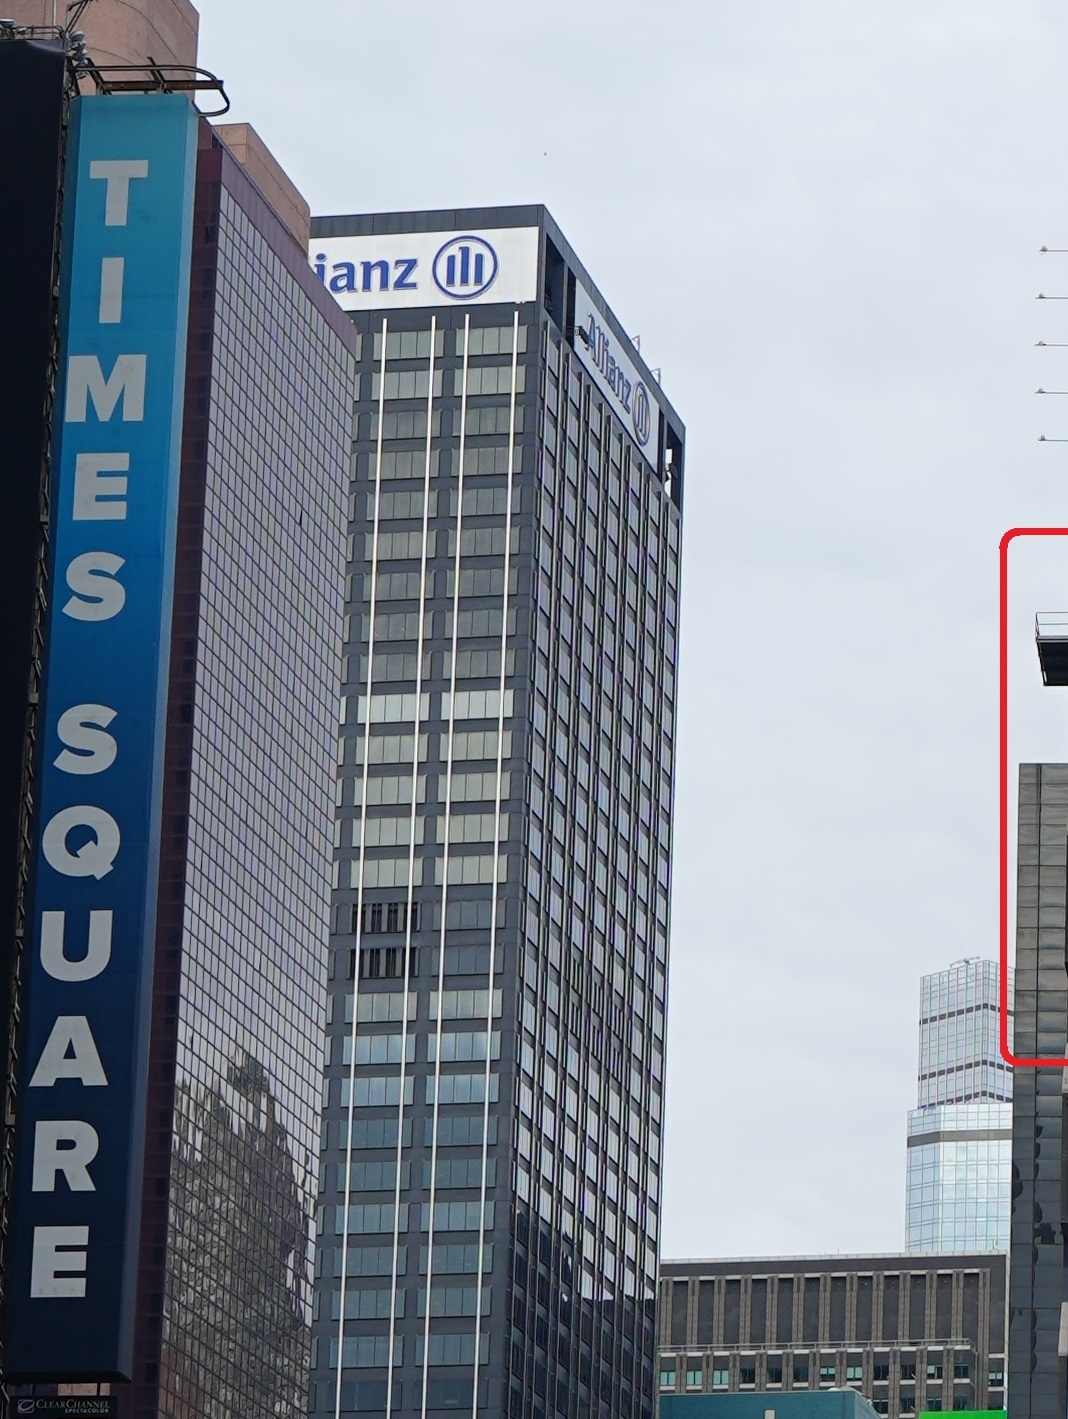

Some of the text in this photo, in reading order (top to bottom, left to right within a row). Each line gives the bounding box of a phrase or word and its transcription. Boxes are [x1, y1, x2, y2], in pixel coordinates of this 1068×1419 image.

[61, 159, 149, 622] TIMES
[314, 253, 420, 294] ianz
[28, 703, 122, 1299] SQUARE
